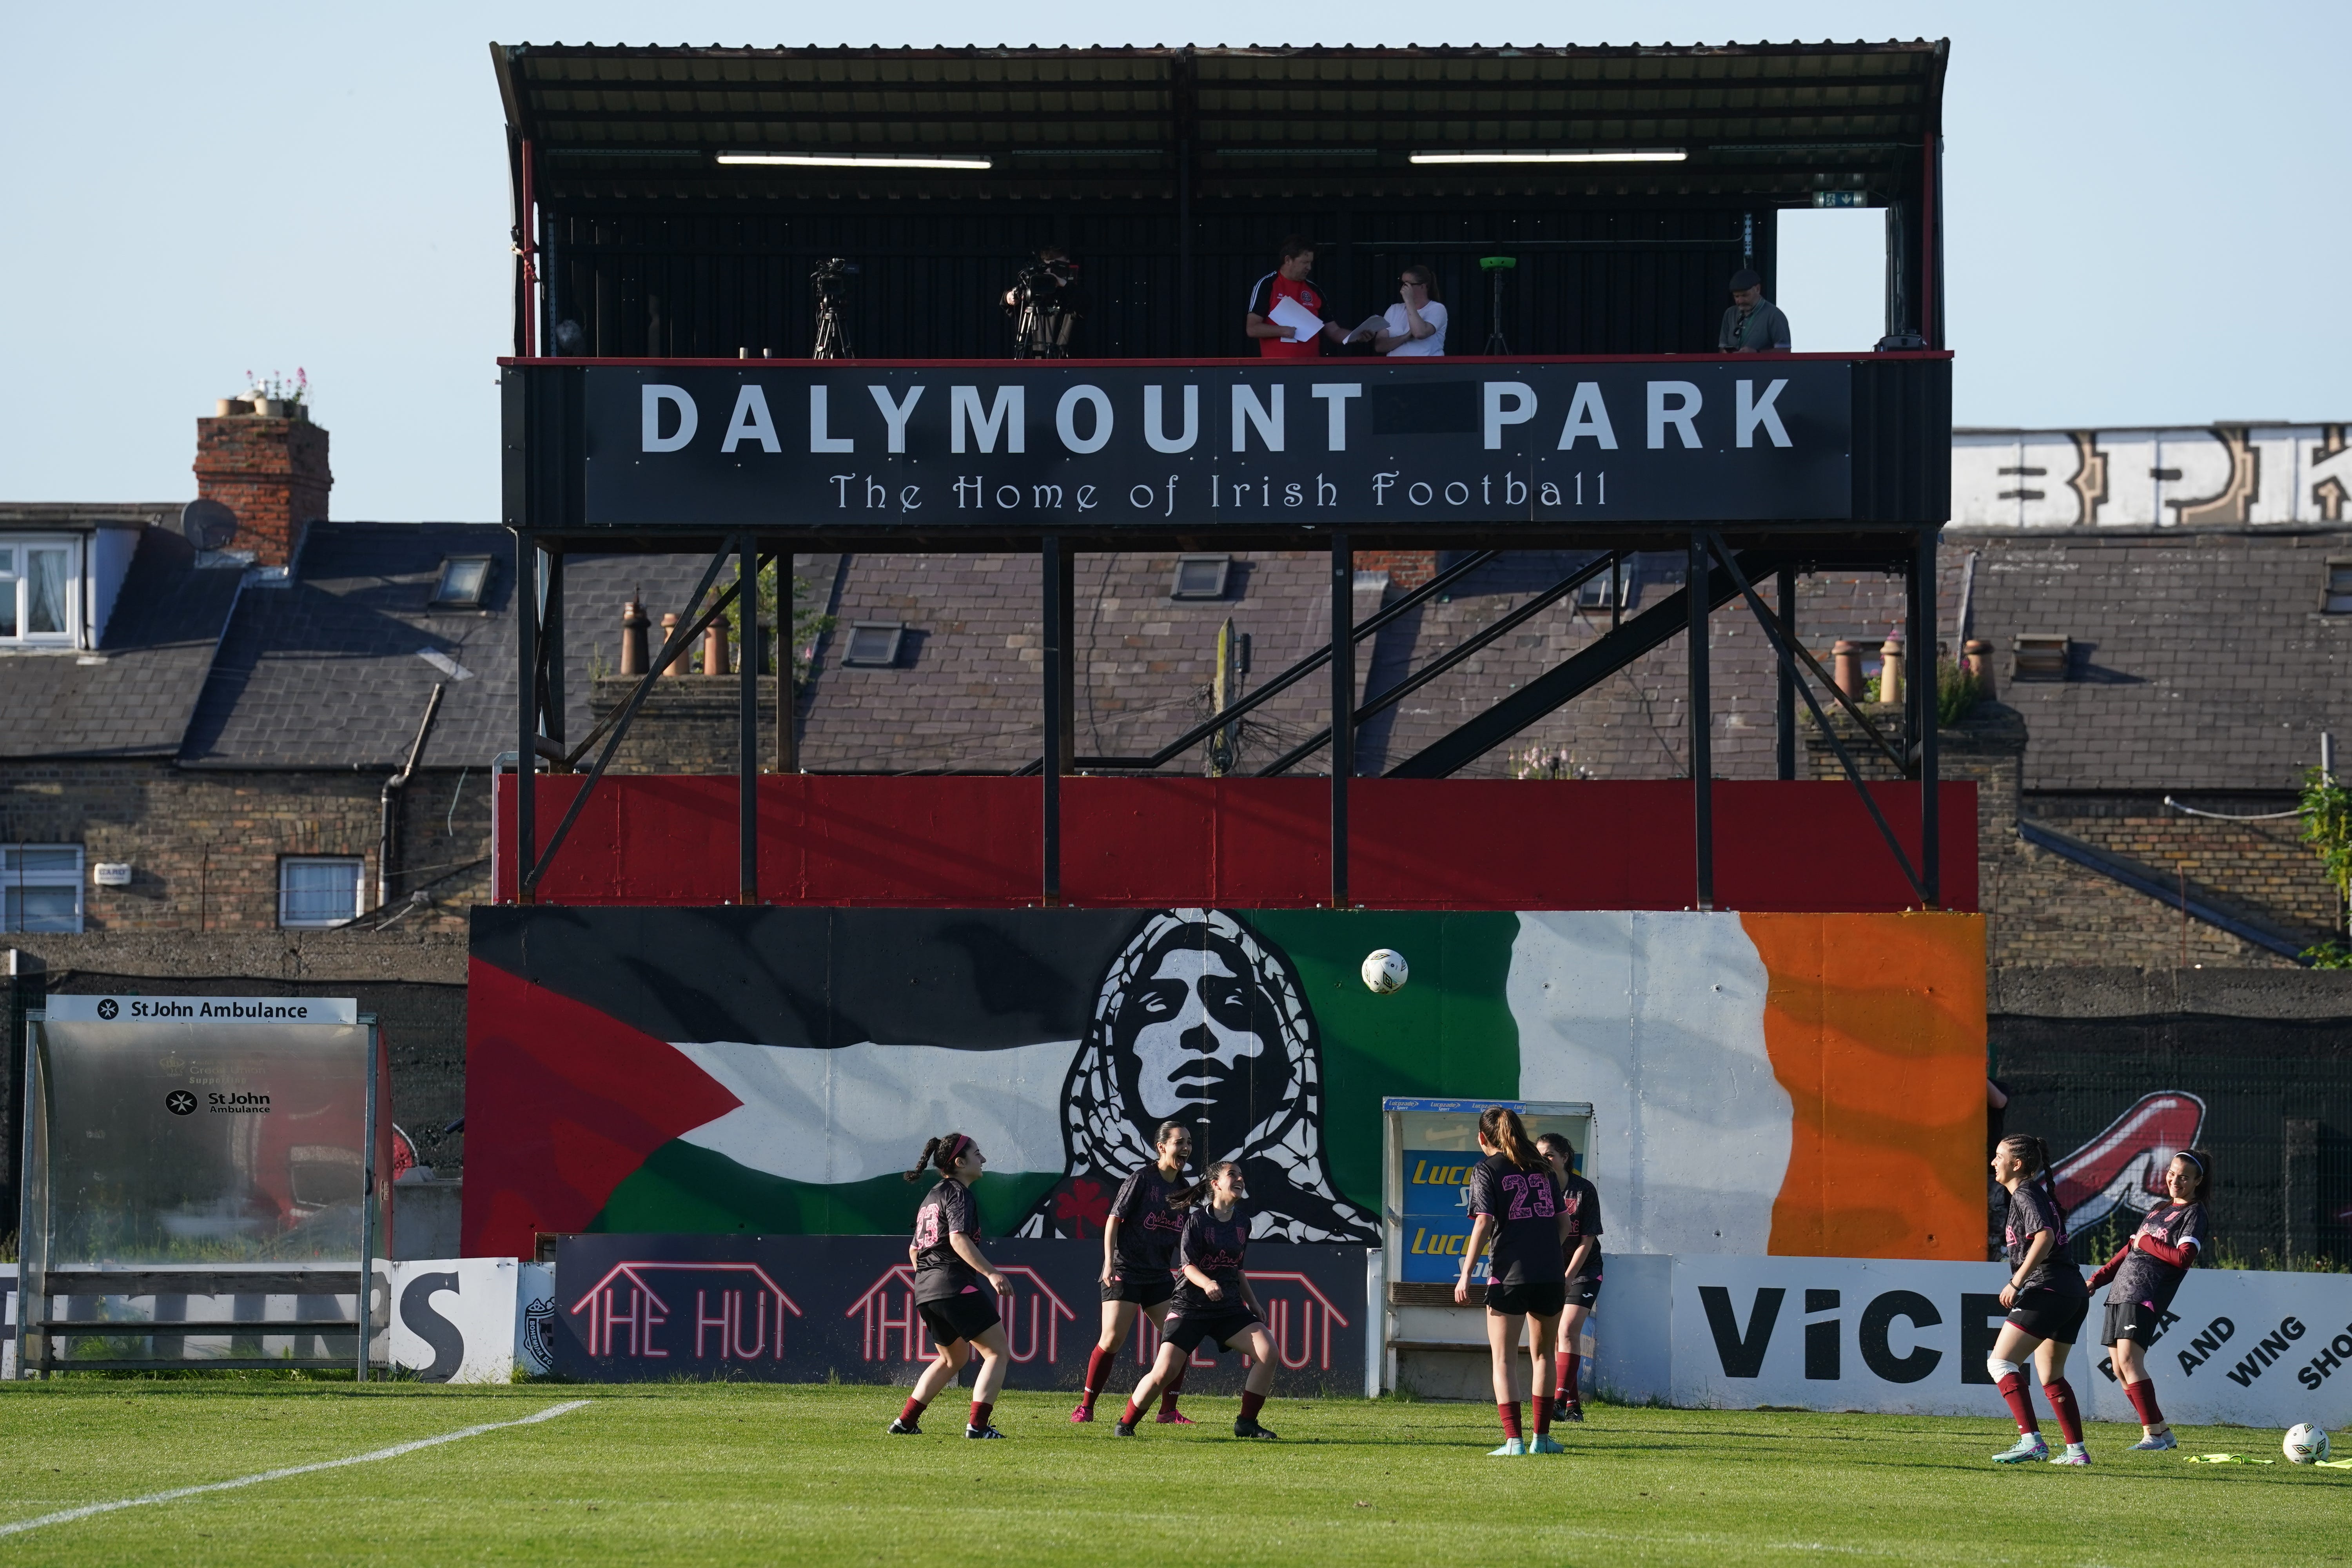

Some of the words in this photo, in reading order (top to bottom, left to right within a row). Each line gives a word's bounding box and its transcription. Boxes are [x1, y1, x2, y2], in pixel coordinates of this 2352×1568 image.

[641, 383, 1362, 455] DALYMOUNT
[1483, 378, 1793, 451] PARK
[829, 472, 922, 508] The
[952, 475, 1098, 510] Home
[1129, 474, 1180, 517] of
[1211, 472, 1338, 508] Irish
[1372, 470, 1606, 507] Football
[131, 1001, 149, 1016] St
[151, 1001, 193, 1017] John
[199, 1002, 308, 1018] Ambulance
[208, 1093, 226, 1105] St
[228, 1092, 270, 1105] John
[1502, 1173, 1555, 1220] 23
[916, 1203, 939, 1250] 23
[572, 1261, 670, 1356] THE
[695, 1270, 802, 1360] HUT
[529, 1320, 544, 1356] BOHEMIAN
[2177, 1316, 2235, 1377] AND
[2225, 1316, 2306, 1388] WING
